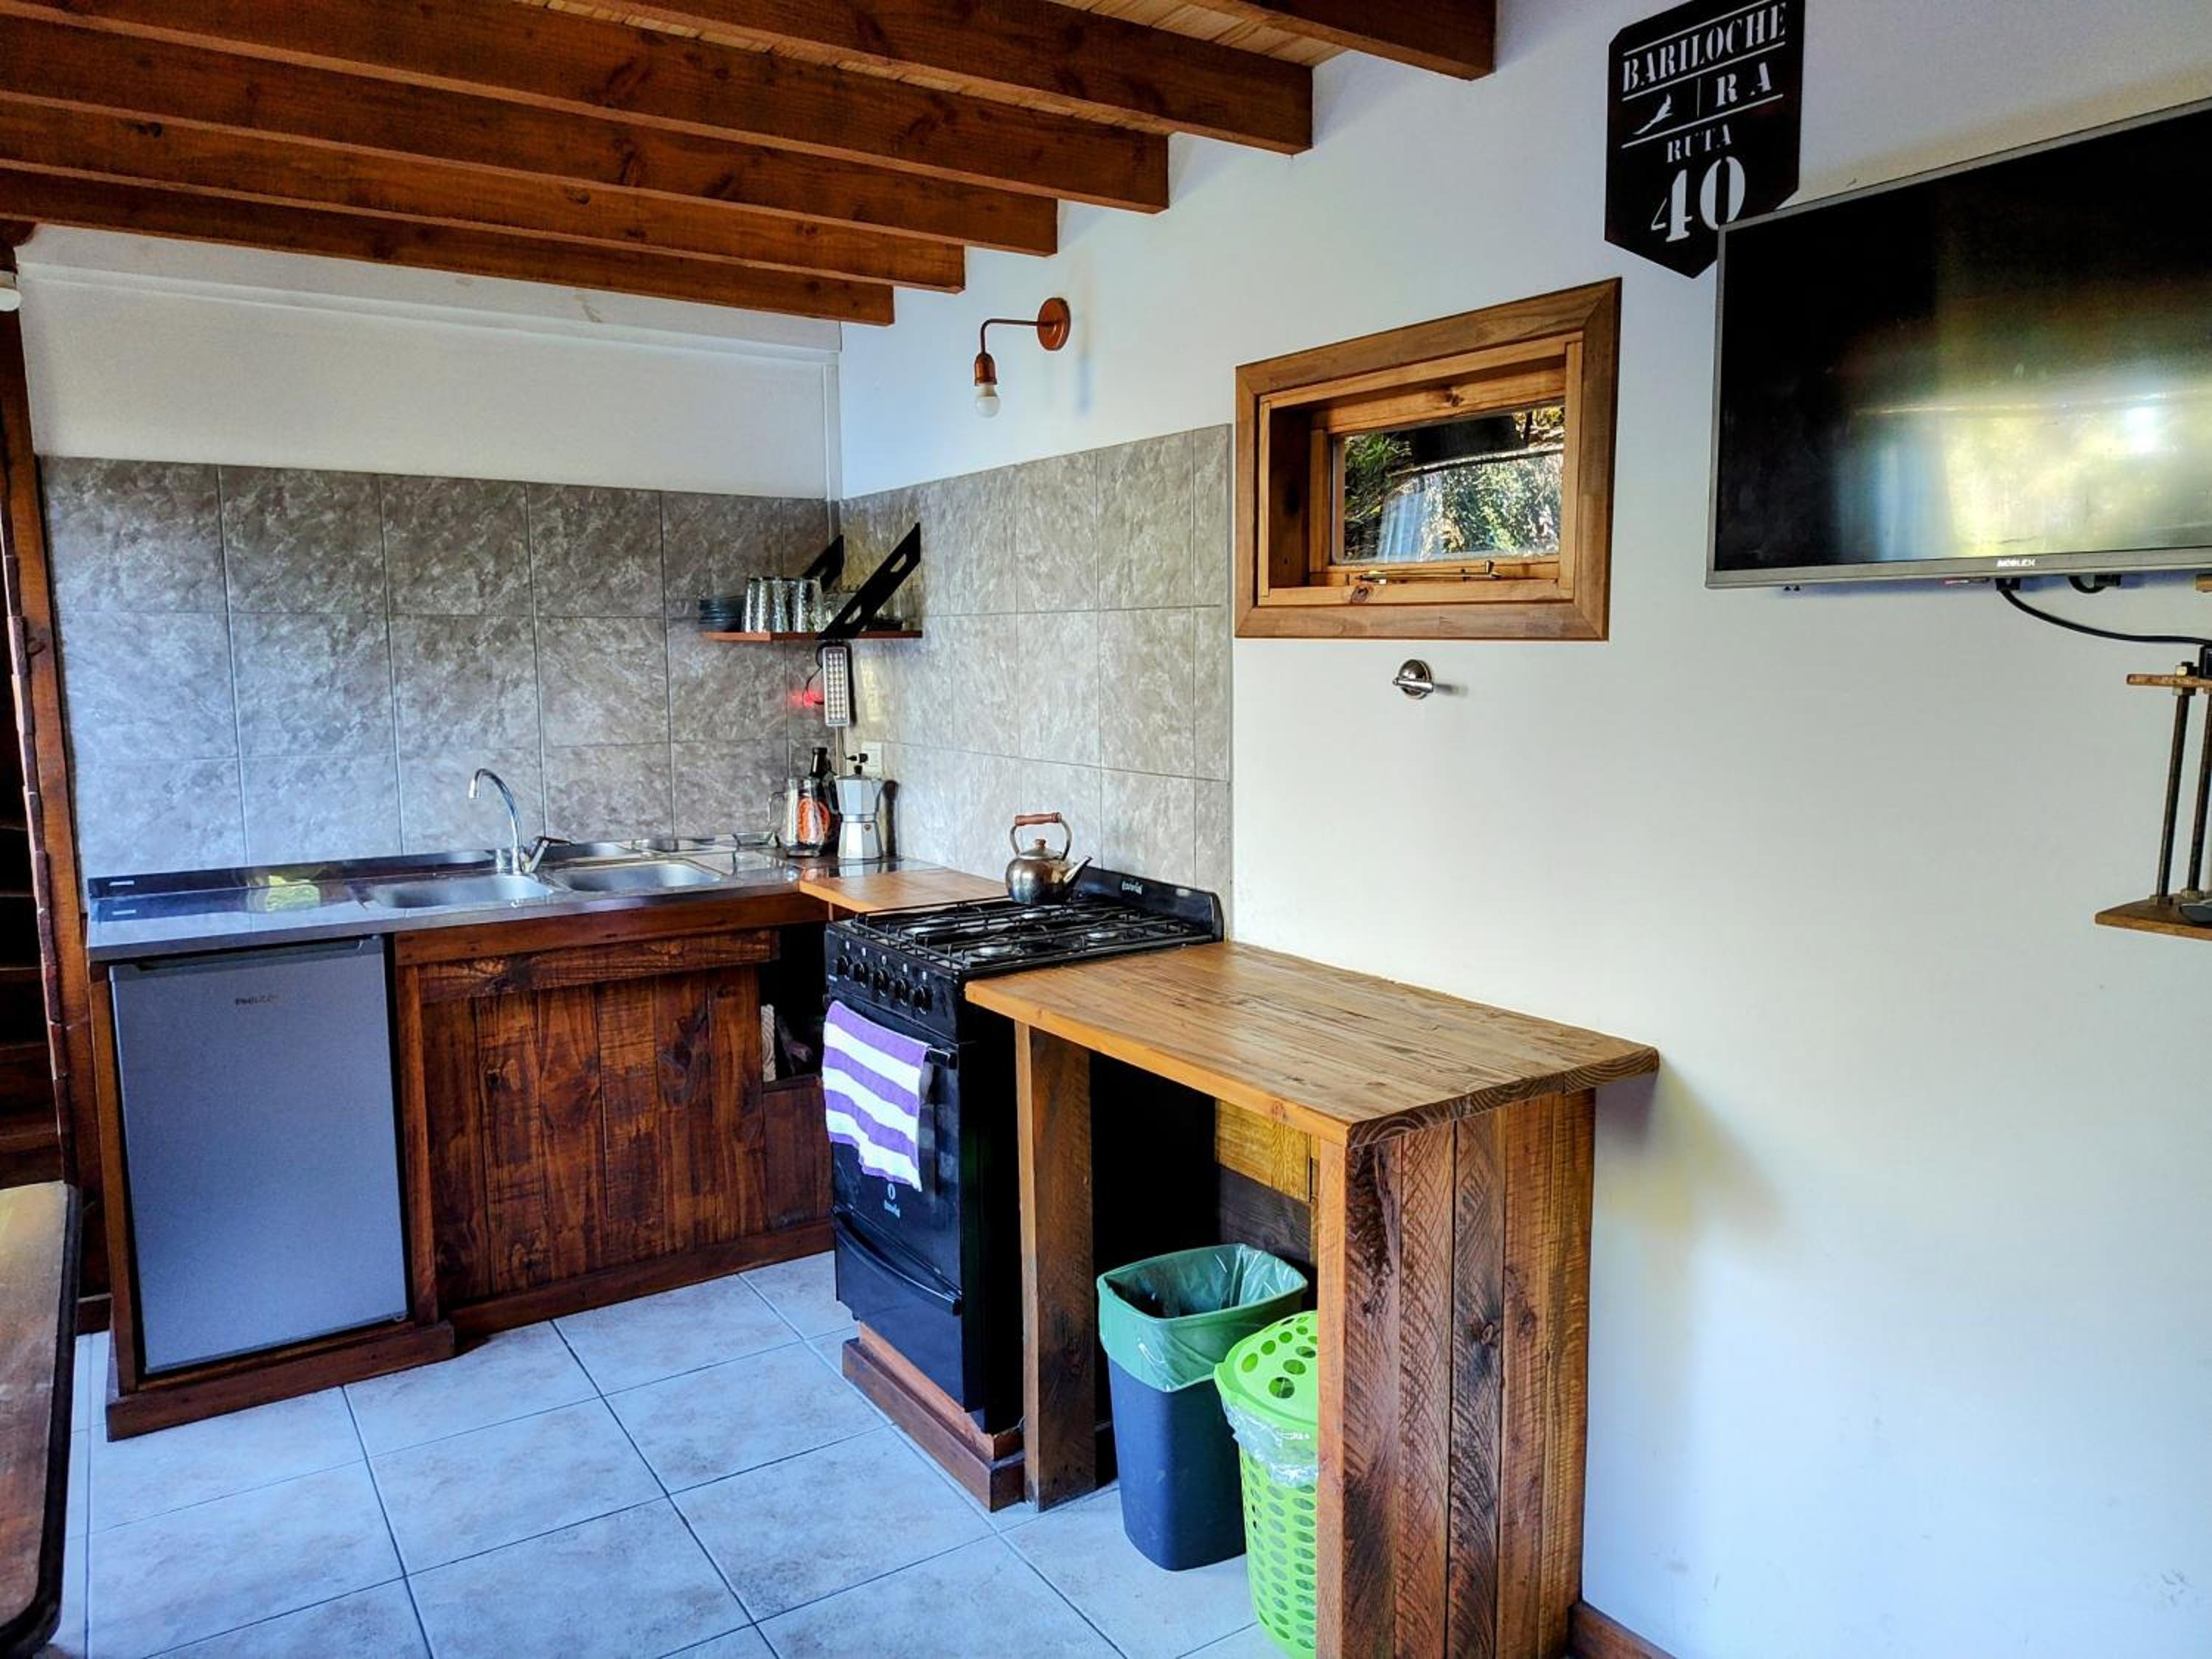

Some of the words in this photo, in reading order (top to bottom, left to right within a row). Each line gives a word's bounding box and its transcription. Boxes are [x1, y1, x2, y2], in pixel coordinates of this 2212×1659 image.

[1623, 2, 1787, 92] BARILOCHE
[1667, 123, 1732, 163] RUTA
[1651, 156, 1746, 243] 40
